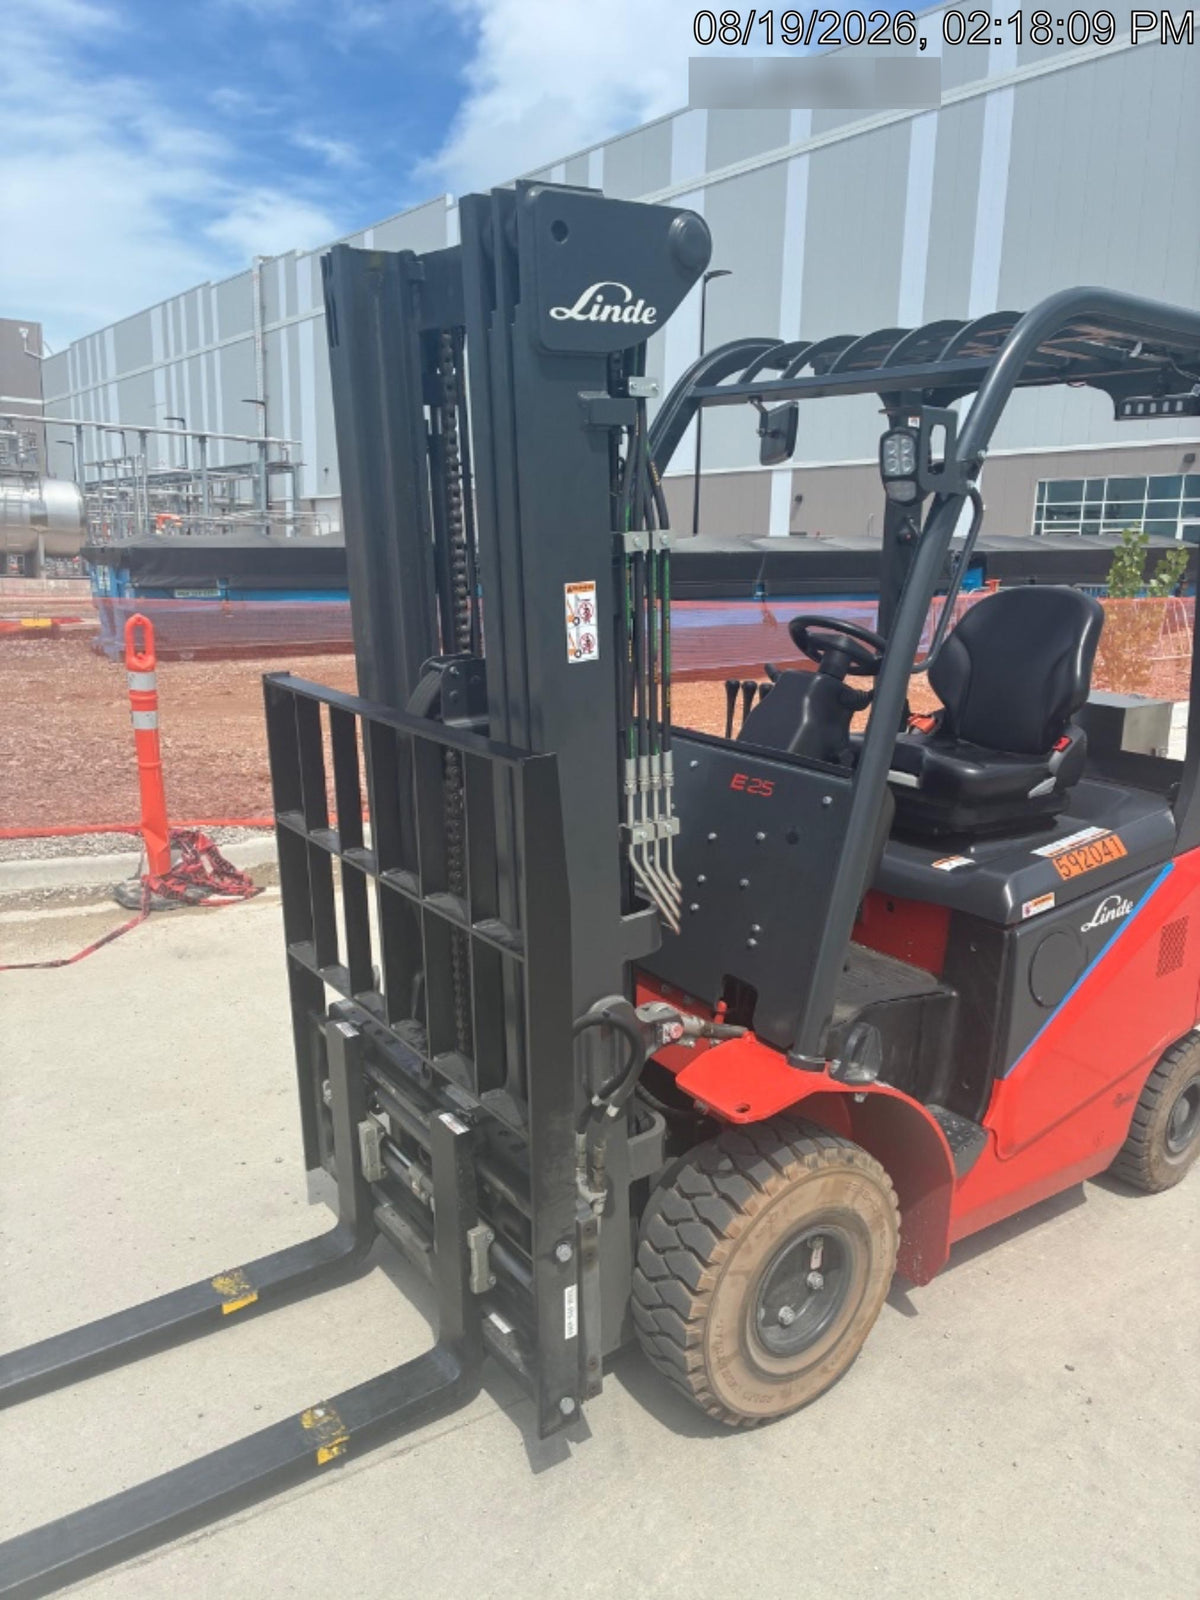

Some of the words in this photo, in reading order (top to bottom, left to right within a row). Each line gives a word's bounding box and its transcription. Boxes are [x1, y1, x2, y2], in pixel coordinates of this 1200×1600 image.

[549, 281, 657, 325] Linde
[1054, 837, 1123, 878] 592041
[1080, 895, 1134, 933] Linde
